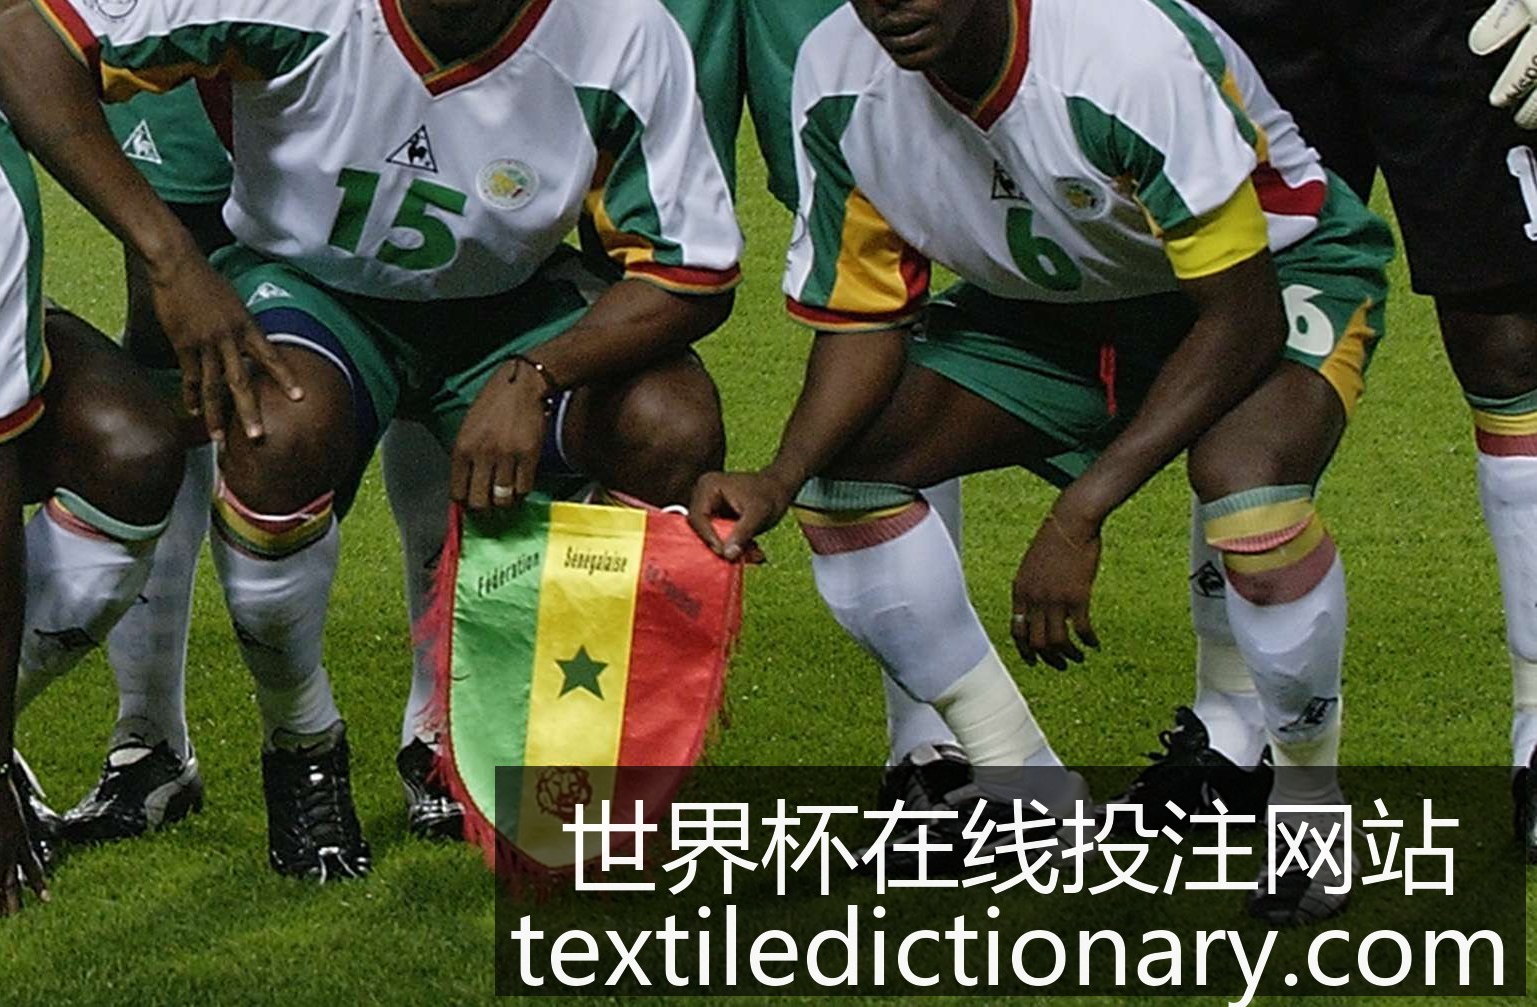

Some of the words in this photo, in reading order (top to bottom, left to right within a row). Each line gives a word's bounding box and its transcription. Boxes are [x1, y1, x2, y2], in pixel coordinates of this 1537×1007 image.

[328, 168, 467, 271] 15
[1006, 207, 1083, 292] 6
[1281, 284, 1335, 358] 6
